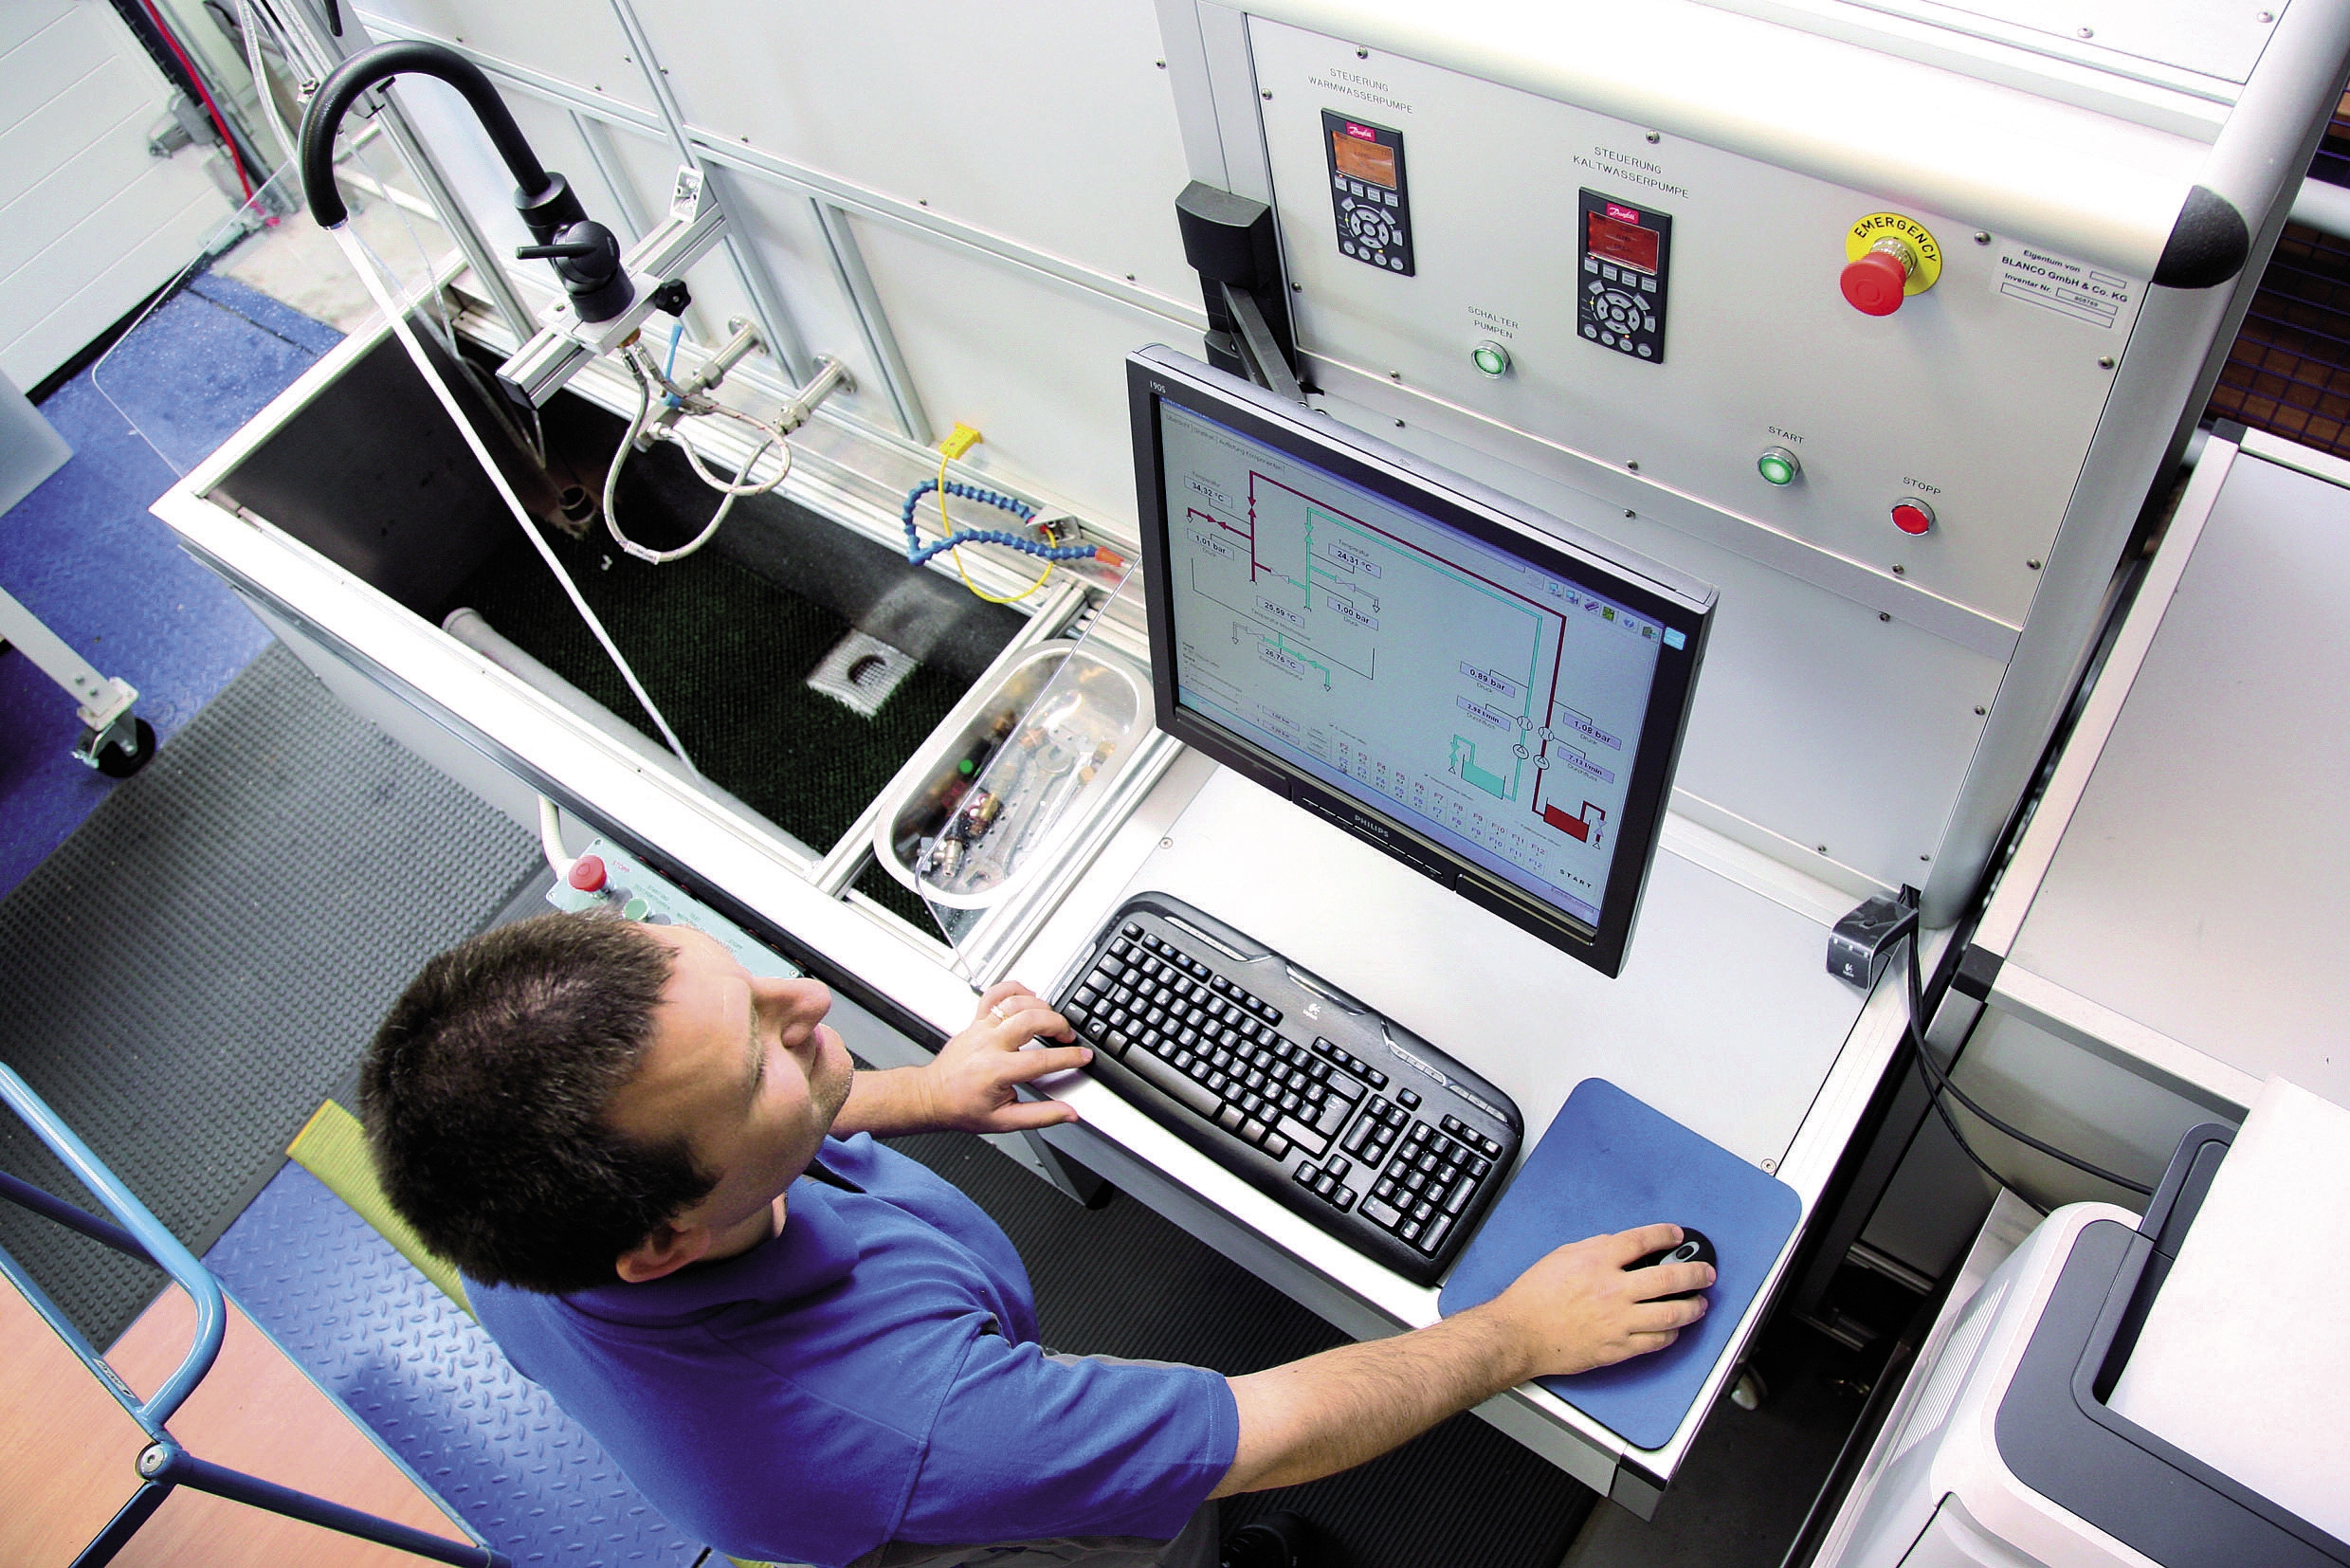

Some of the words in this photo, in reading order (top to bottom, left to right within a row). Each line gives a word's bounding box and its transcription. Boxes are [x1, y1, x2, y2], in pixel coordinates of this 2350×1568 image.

[1330, 67, 1389, 92] STEUERUNG
[1307, 75, 1413, 114] WARMWASSERPUMPE
[1594, 146, 1662, 174] STEUERUNG
[1573, 155, 1689, 199] KALTWASSERPUMPE
[1854, 216, 1937, 263] EMERGENCY
[2023, 249, 2063, 267] Eigentum
[2065, 263, 2081, 273] von
[2001, 256, 2046, 276] BLANCO
[2048, 271, 2080, 287] GmbH
[2091, 285, 2108, 297] Co.
[2111, 291, 2128, 302] KG
[2004, 273, 2038, 288] Inventar
[2040, 283, 2052, 294] Nr.
[1467, 305, 1519, 329] SCHALTER
[1474, 319, 1513, 339] PUMPEN
[1768, 426, 1805, 445] START
[1903, 476, 1941, 495] STOPP
[1213, 542, 1226, 555] bar
[1356, 611, 1370, 624] bar
[1490, 678, 1505, 691] bar
[1594, 729, 1612, 743] bar
[1355, 814, 1390, 838] PHILIPS
[1559, 868, 1592, 888] START
